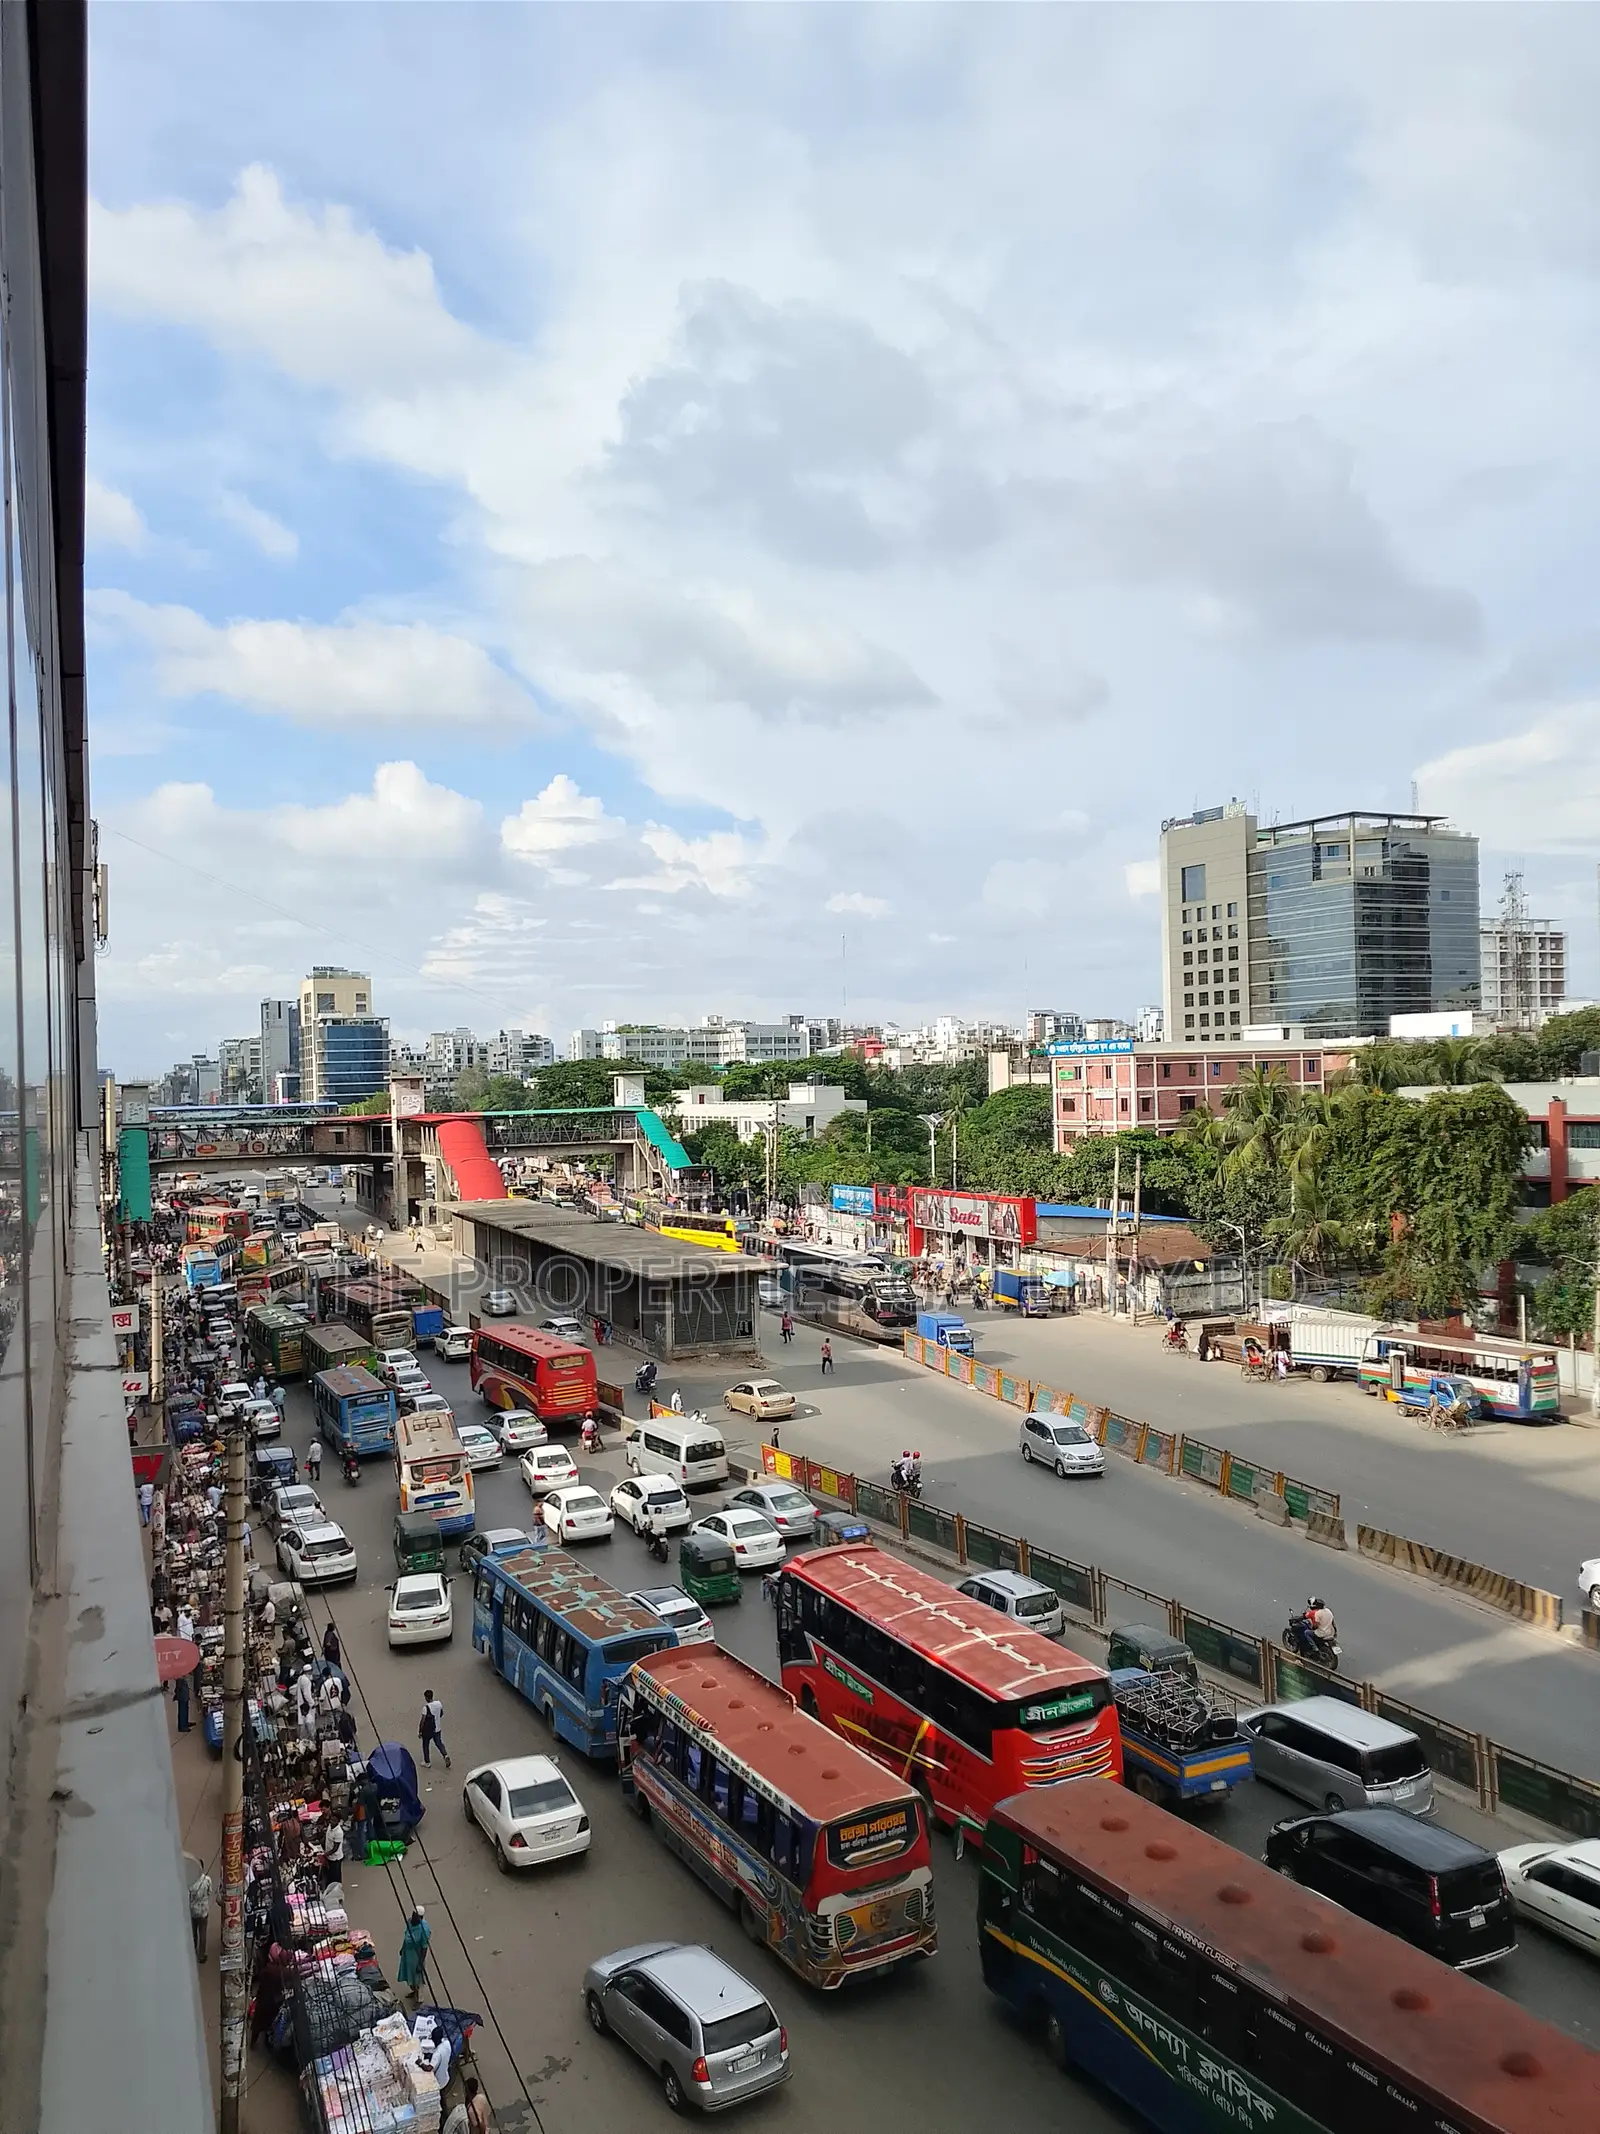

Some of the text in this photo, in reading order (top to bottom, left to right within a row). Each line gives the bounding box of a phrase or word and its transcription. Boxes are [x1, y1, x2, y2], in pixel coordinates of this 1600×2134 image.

[949, 1206, 983, 1226] Bata
[1204, 1945, 1238, 1972] CLASSIC
[1122, 1995, 1278, 2123] অনন্যা ক্লাসিক
[1176, 2063, 1210, 2098] পরিবহন
